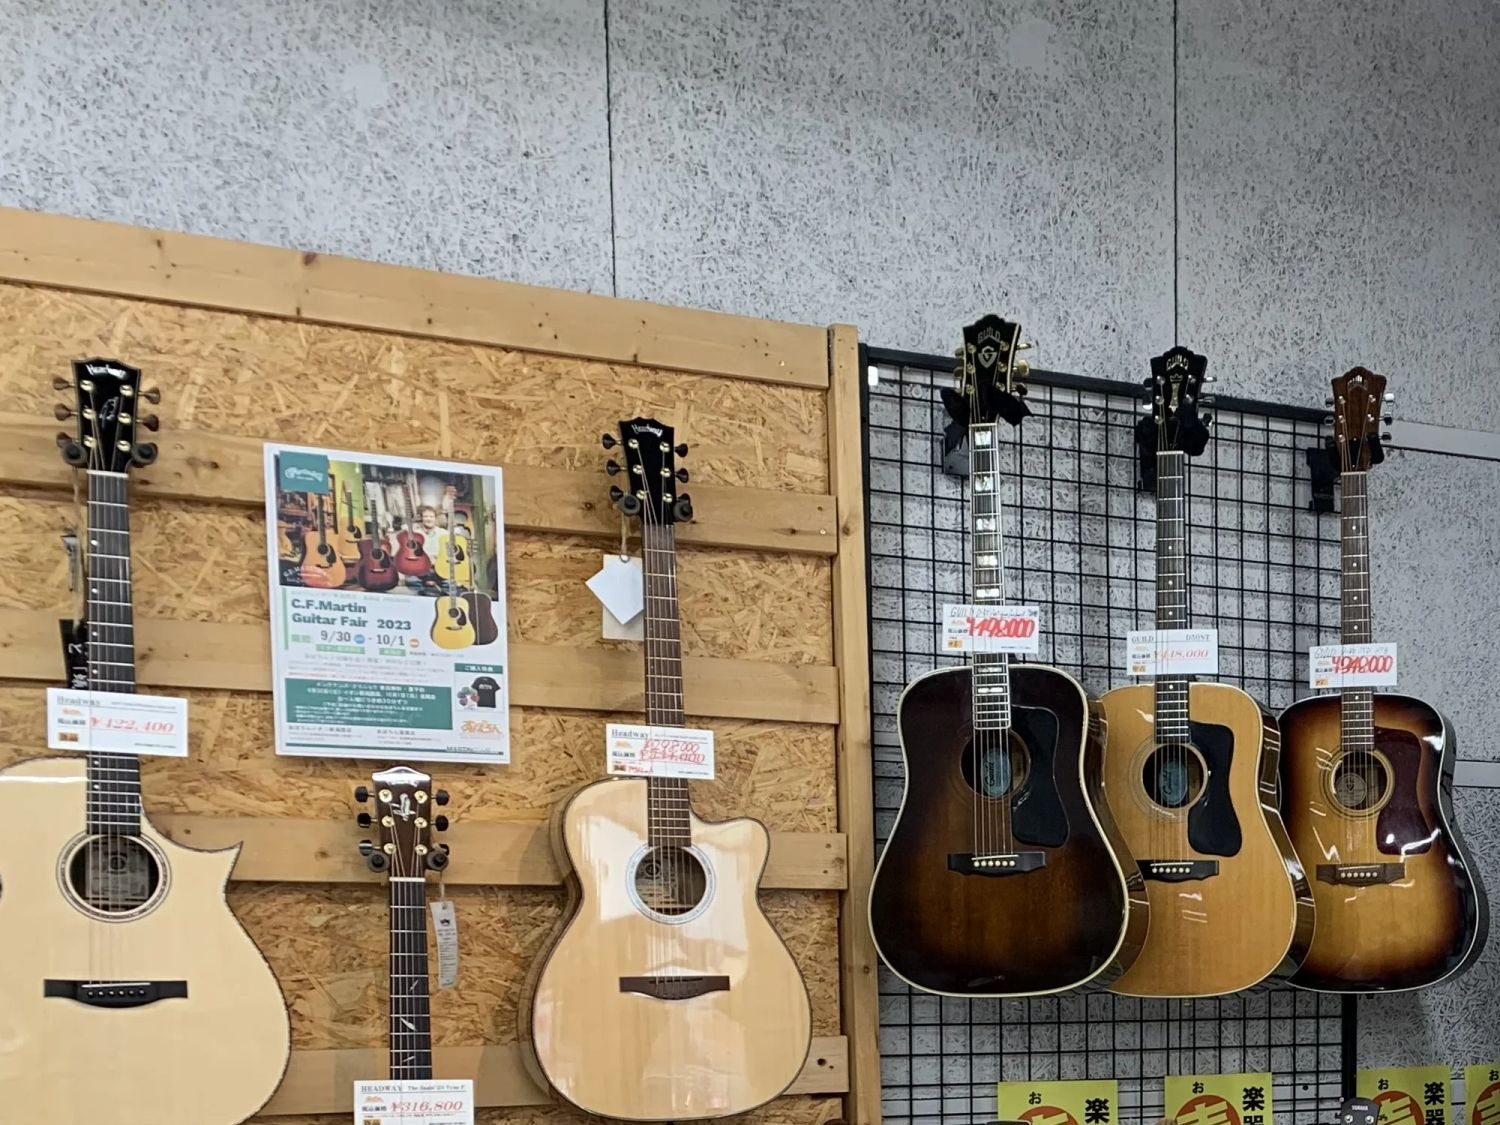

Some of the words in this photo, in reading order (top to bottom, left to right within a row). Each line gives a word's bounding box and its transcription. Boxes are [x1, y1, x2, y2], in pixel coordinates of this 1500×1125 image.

[977, 326, 1001, 343] GUILD
[1166, 358, 1189, 372] GUILD
[291, 598, 367, 614] C.F.Martin
[292, 612, 338, 627] Guitar
[340, 615, 368, 628] Fair
[377, 618, 412, 631] 2023
[320, 630, 351, 643] 9/30
[376, 633, 405, 646] 10/1
[611, 729, 649, 738] Headway
